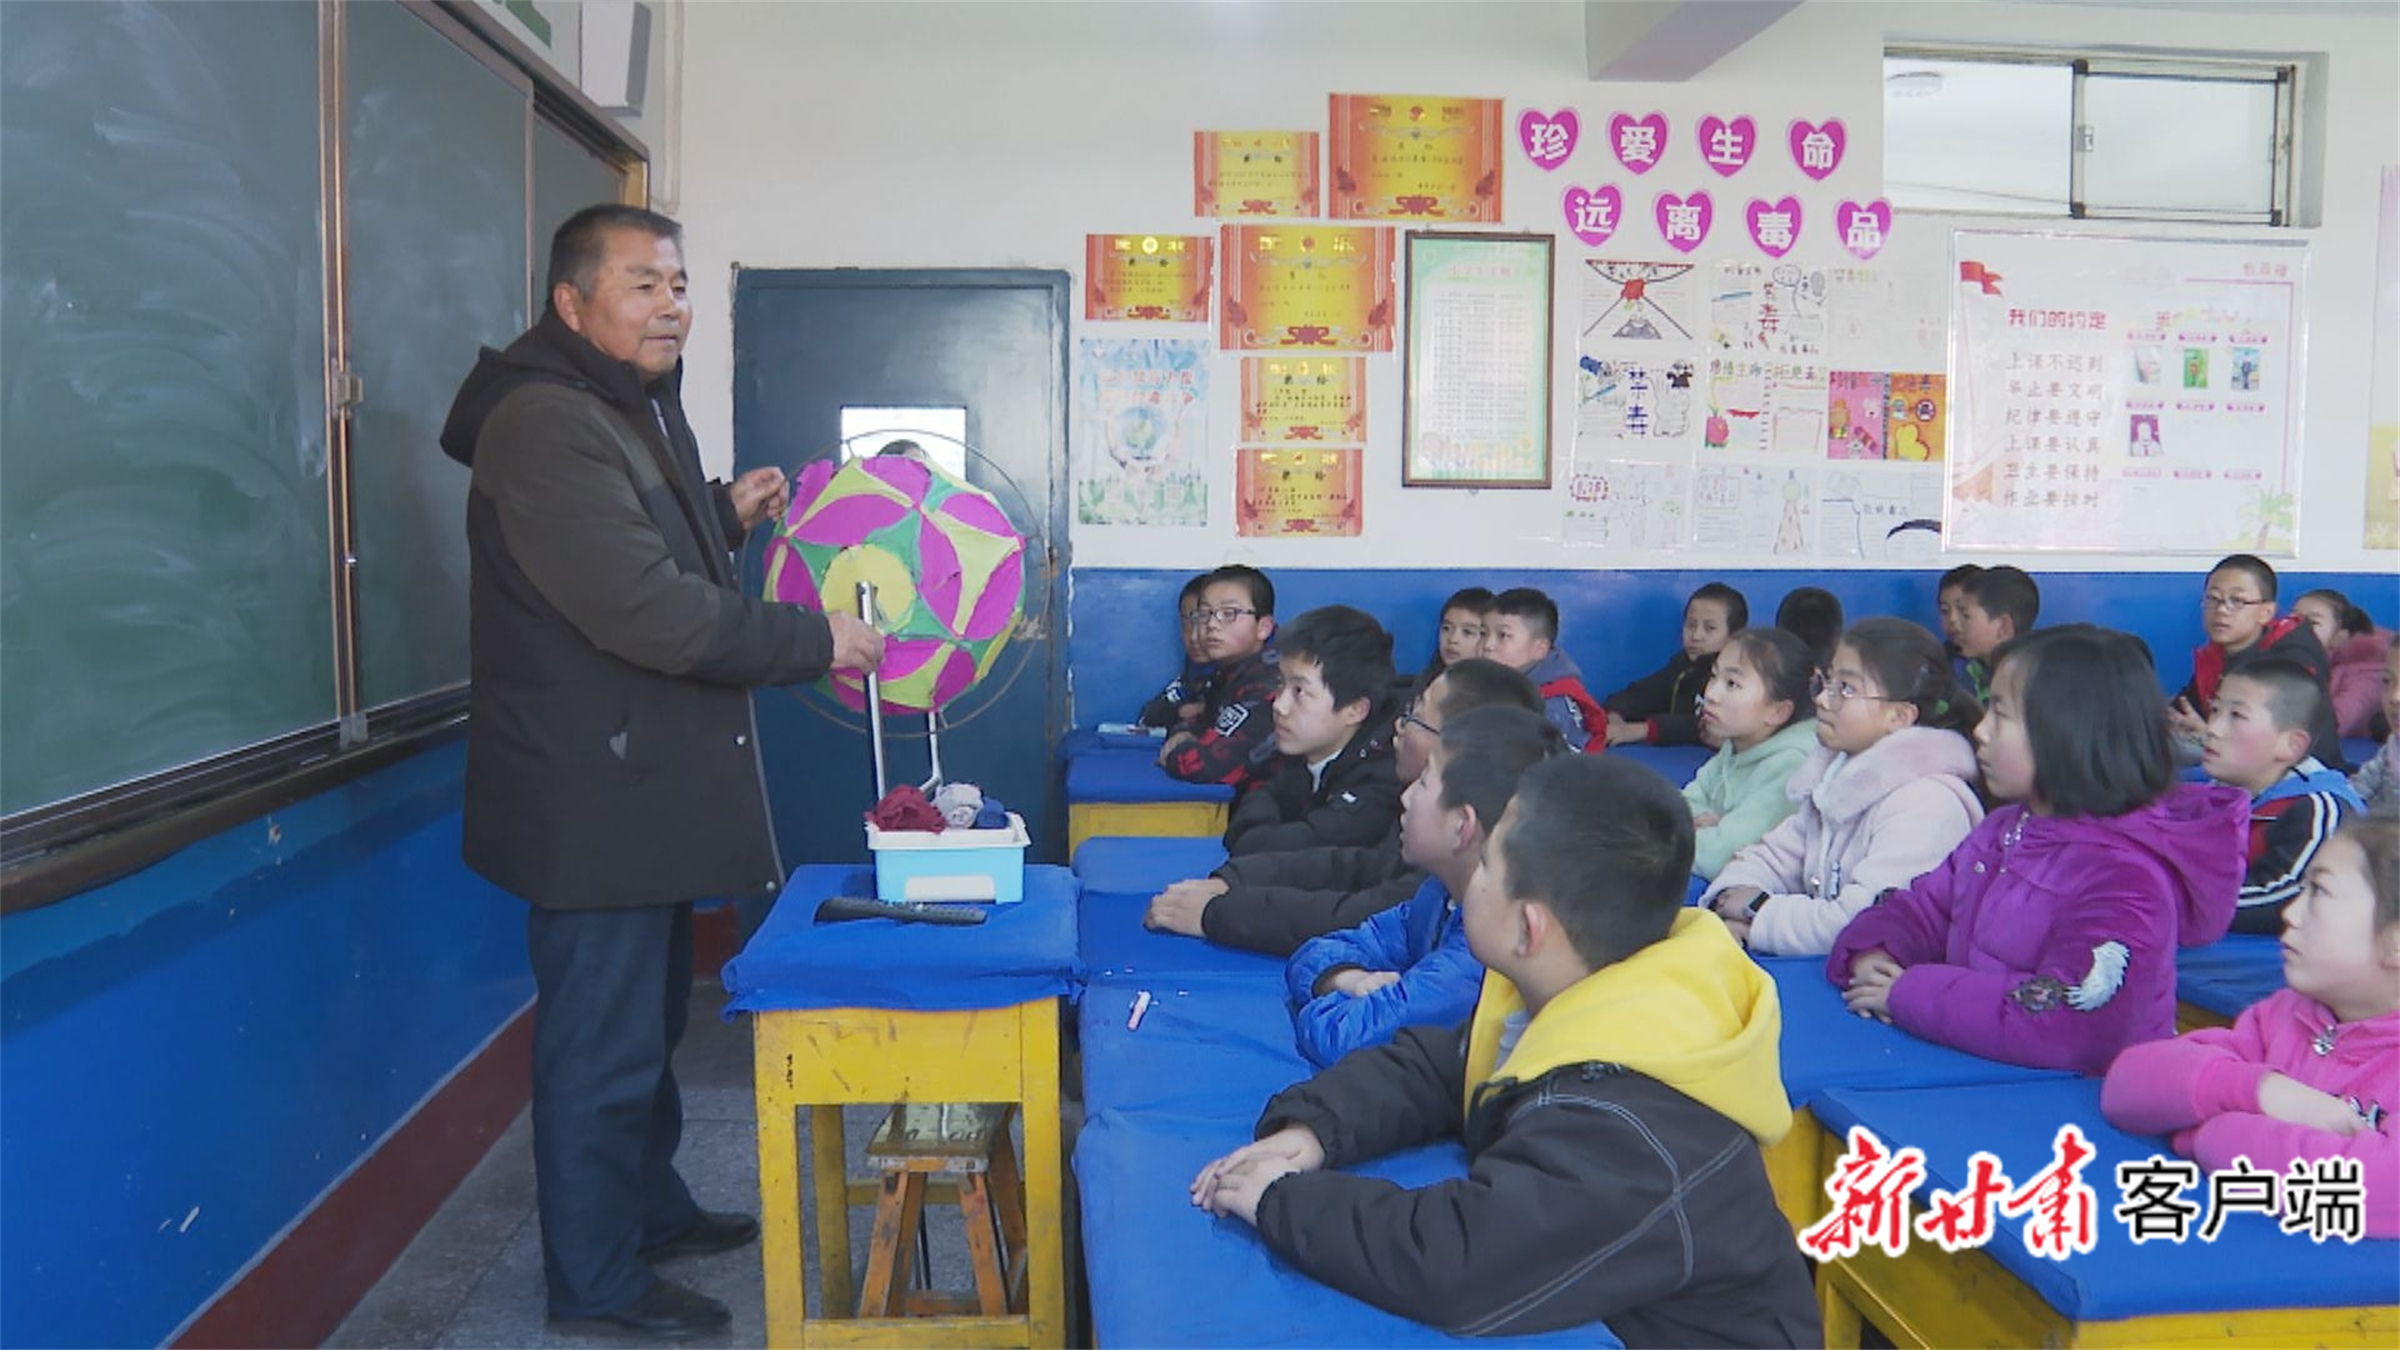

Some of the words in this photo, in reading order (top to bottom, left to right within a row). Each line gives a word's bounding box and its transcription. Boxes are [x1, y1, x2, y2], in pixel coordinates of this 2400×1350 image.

[1529, 121, 1837, 171] 珍爱生命
[1573, 195, 1882, 251] 远离毒品
[2008, 308, 2107, 330] 我们的约定
